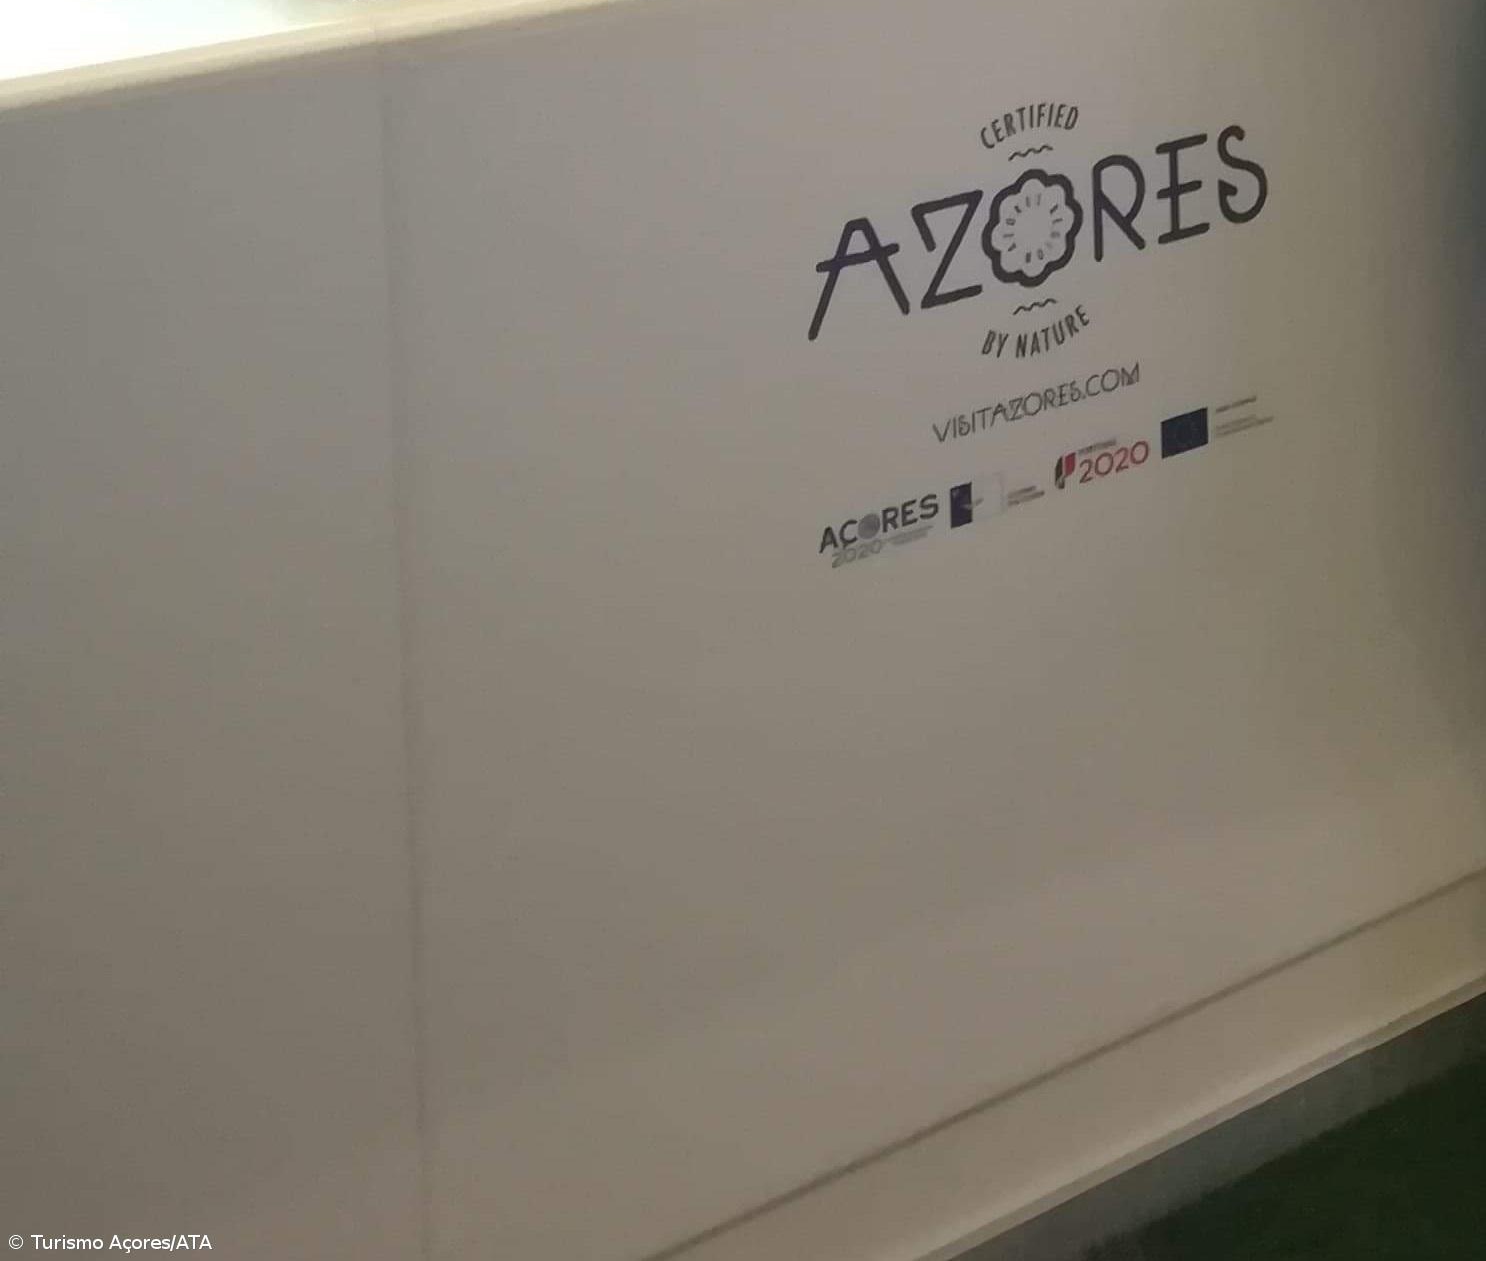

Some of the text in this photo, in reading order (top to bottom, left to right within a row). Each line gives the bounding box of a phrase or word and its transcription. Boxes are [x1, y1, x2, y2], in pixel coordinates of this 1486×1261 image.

[980, 102, 1080, 150] CERTIFIED
[807, 124, 1269, 342] AZORES
[981, 304, 1090, 359] BY NATURE
[932, 363, 1141, 444] VISITAZORES.COM
[1079, 440, 1150, 484] 2020
